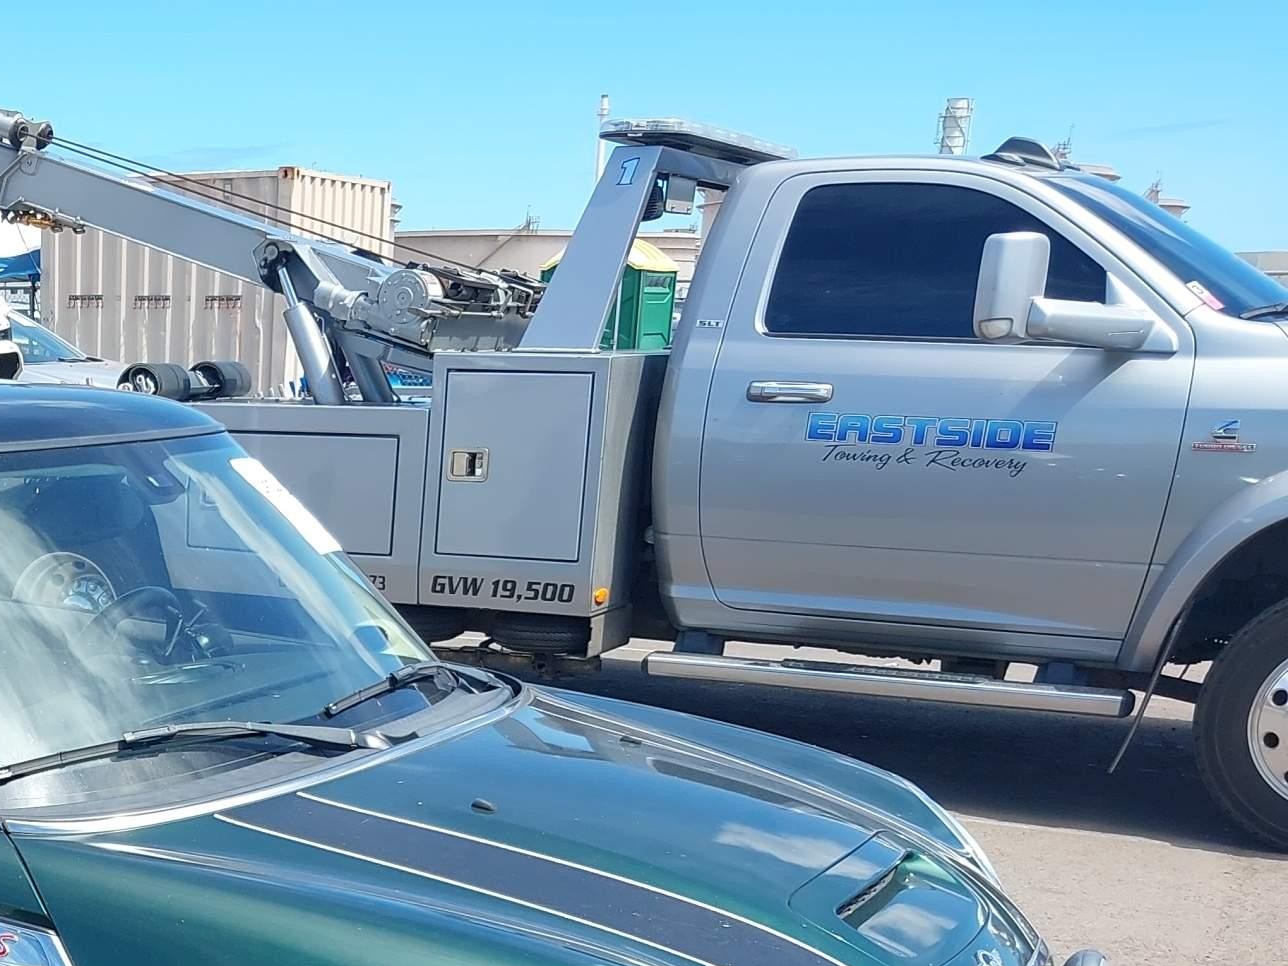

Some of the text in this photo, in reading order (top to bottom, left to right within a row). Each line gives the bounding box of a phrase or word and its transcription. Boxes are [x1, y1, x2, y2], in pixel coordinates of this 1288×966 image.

[616, 157, 641, 186] 1
[805, 412, 1058, 452] EASTSIDE
[822, 444, 1029, 478] Towing & Recovery
[431, 575, 576, 603] GVW 19,500
